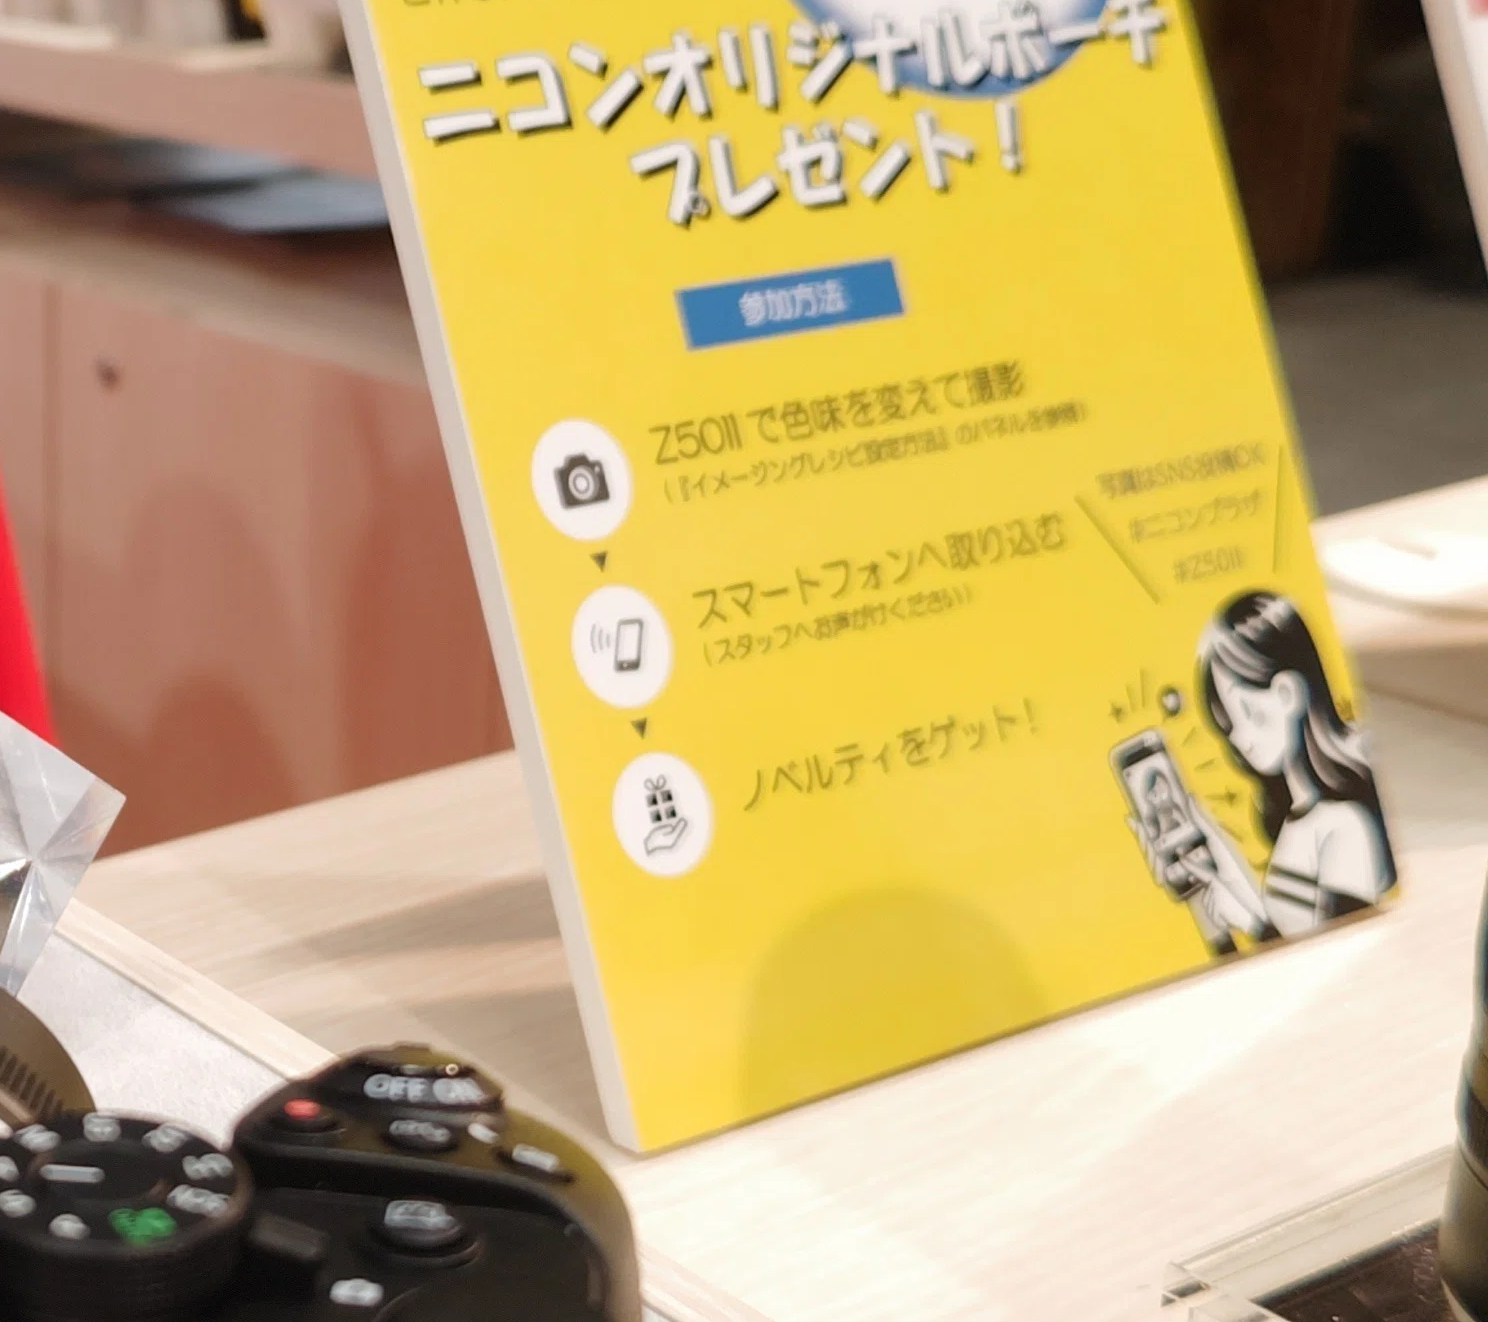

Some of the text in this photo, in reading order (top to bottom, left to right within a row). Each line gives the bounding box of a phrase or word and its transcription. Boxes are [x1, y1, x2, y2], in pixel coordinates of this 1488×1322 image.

[628, 98, 1025, 228] プレゼント!
[738, 279, 848, 328] 参加方法
[691, 511, 1068, 629] スマートフォンへ取り込む
